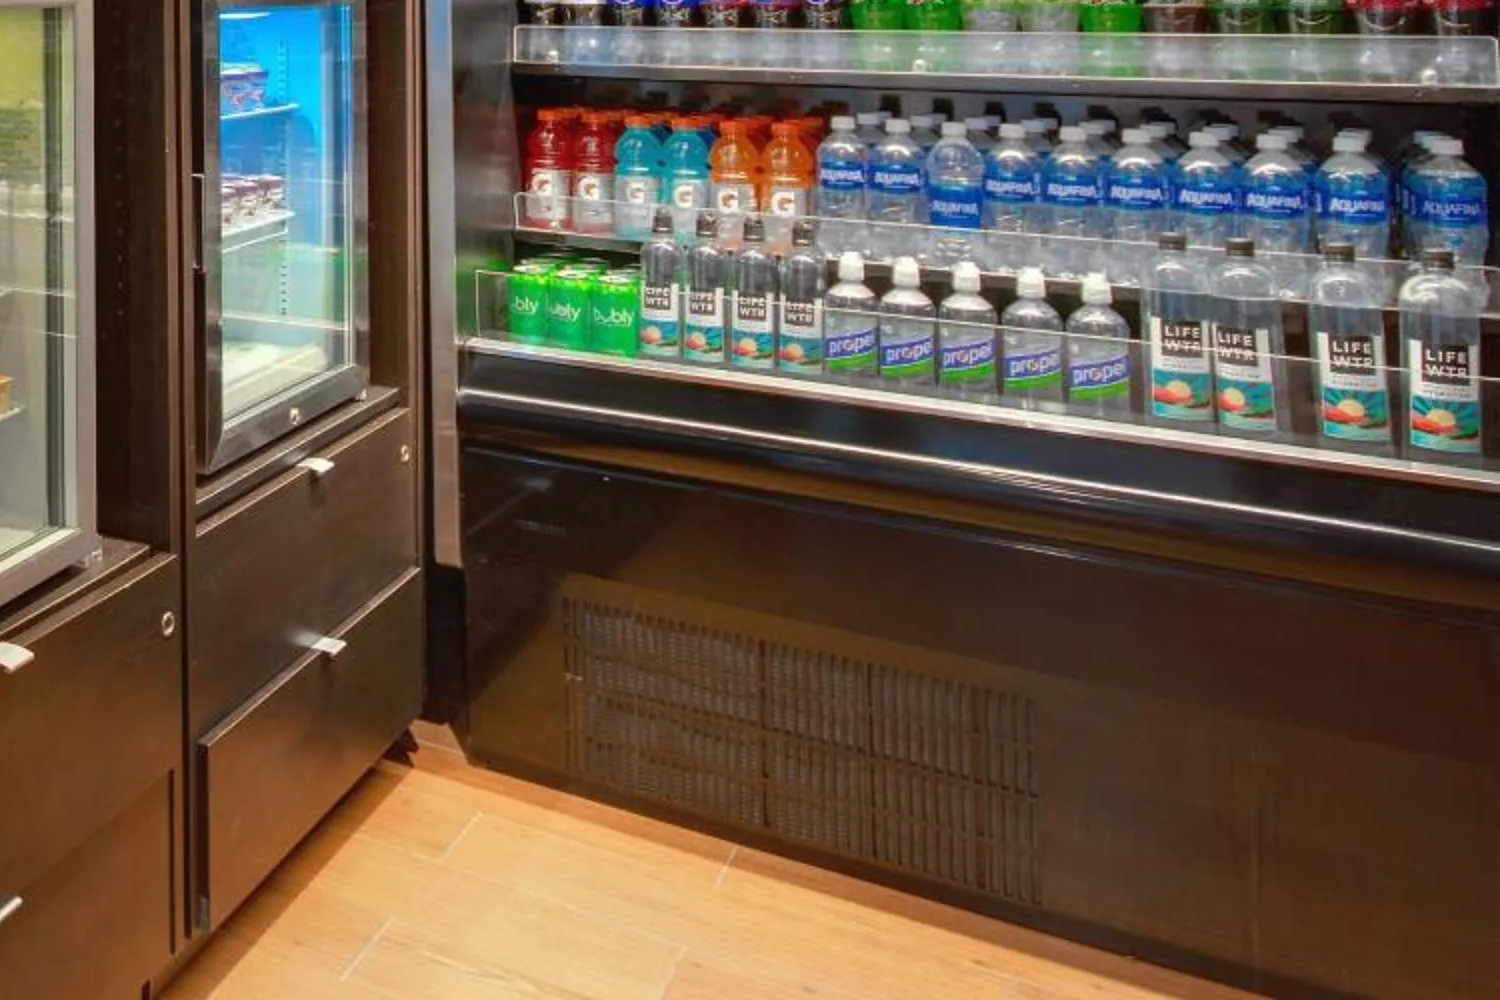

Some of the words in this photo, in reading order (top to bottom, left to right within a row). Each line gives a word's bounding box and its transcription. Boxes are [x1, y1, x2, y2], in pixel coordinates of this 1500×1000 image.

[626, 182, 645, 204] G
[672, 185, 693, 208] G
[717, 188, 738, 214] G
[771, 189, 796, 216] G
[515, 295, 539, 315] bly
[550, 302, 581, 322] ubly
[593, 306, 634, 327] bubly
[1165, 326, 1201, 340] LIFE
[1217, 331, 1253, 347] LIFE
[1332, 340, 1371, 355] LIFE
[1427, 349, 1467, 364] LIFE
